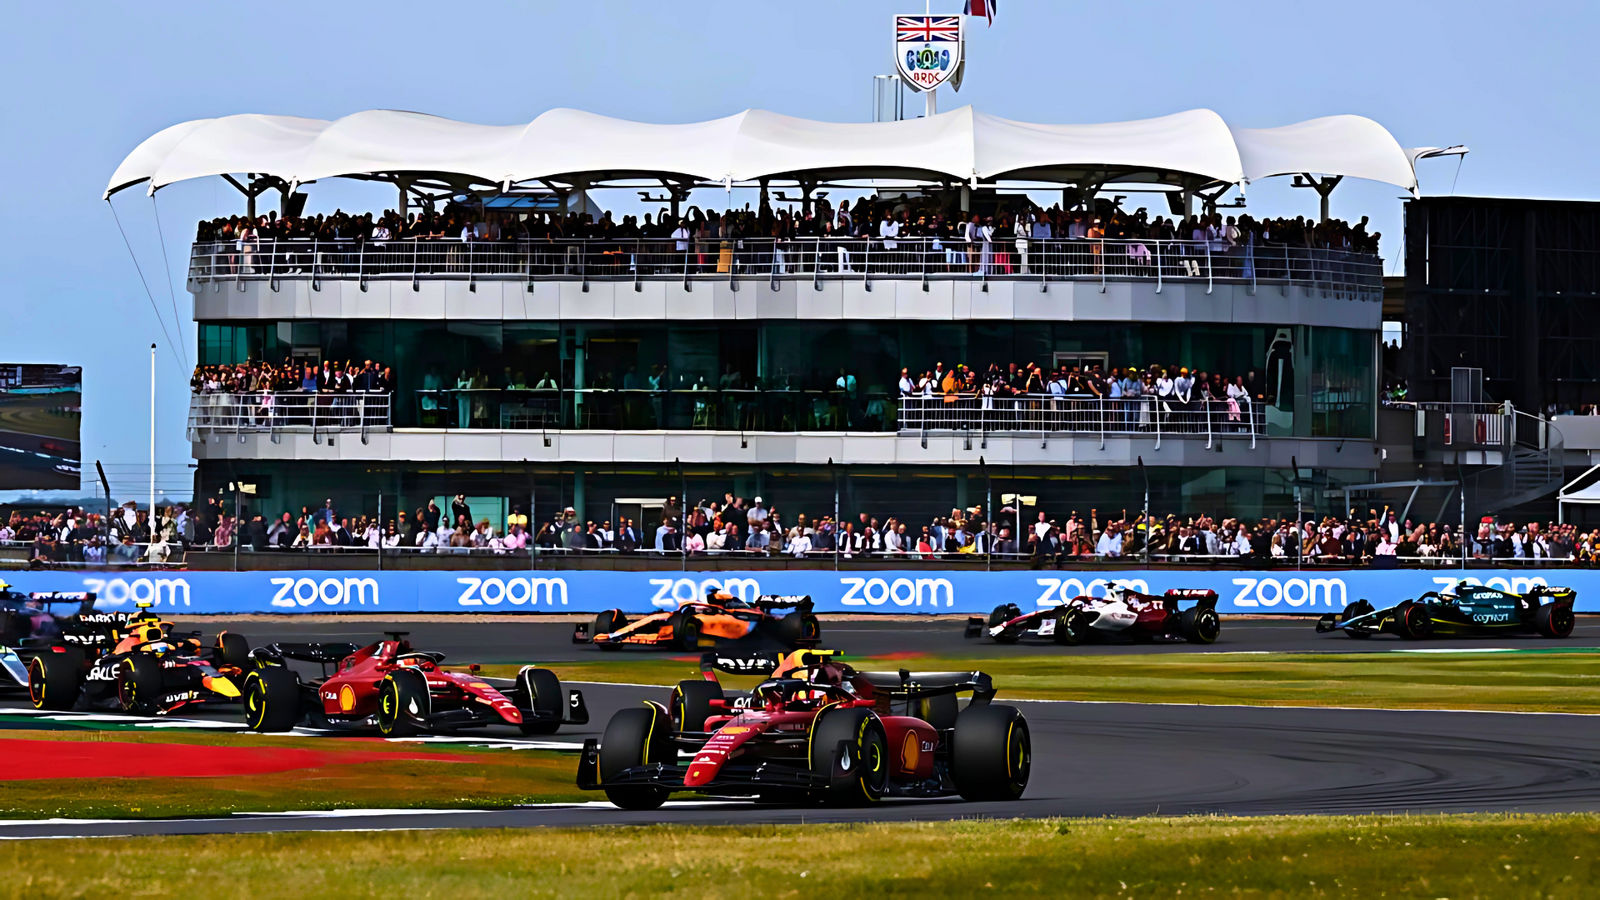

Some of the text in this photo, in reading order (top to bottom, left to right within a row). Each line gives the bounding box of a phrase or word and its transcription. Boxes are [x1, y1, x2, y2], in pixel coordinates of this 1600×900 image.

[913, 72, 941, 84] BRDC
[83, 578, 190, 607] zoom
[270, 577, 379, 607] zoom
[457, 577, 568, 606] zoom
[840, 577, 953, 607] zoom
[1232, 577, 1347, 607] zoom
[1432, 577, 1547, 595] zom
